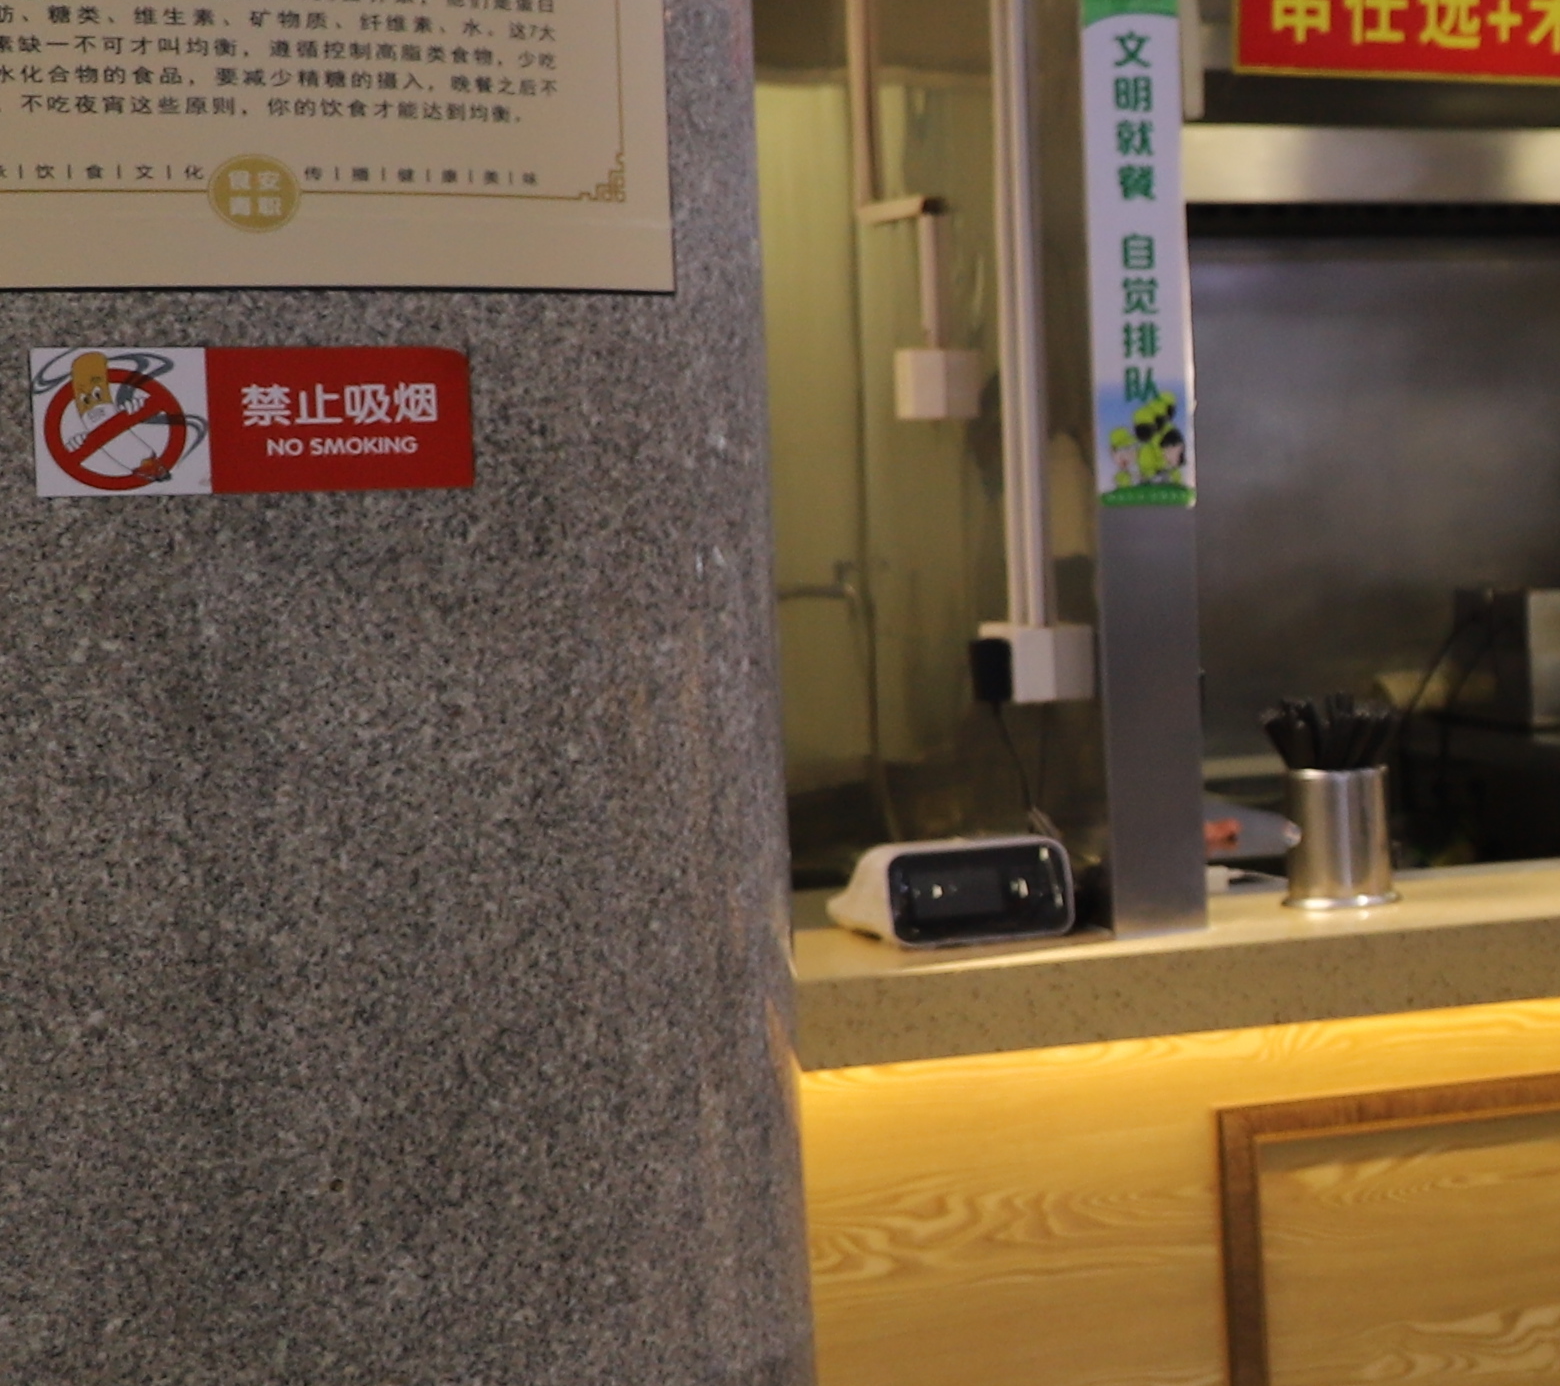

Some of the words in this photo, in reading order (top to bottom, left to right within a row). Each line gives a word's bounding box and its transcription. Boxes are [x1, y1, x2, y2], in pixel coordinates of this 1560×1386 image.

[1114, 31, 1156, 202] 文明就餐
[1121, 232, 1162, 403] 自觉排队
[241, 383, 438, 427] 禁止吸烟
[266, 438, 303, 457] NO
[310, 434, 418, 456] SMOKING
